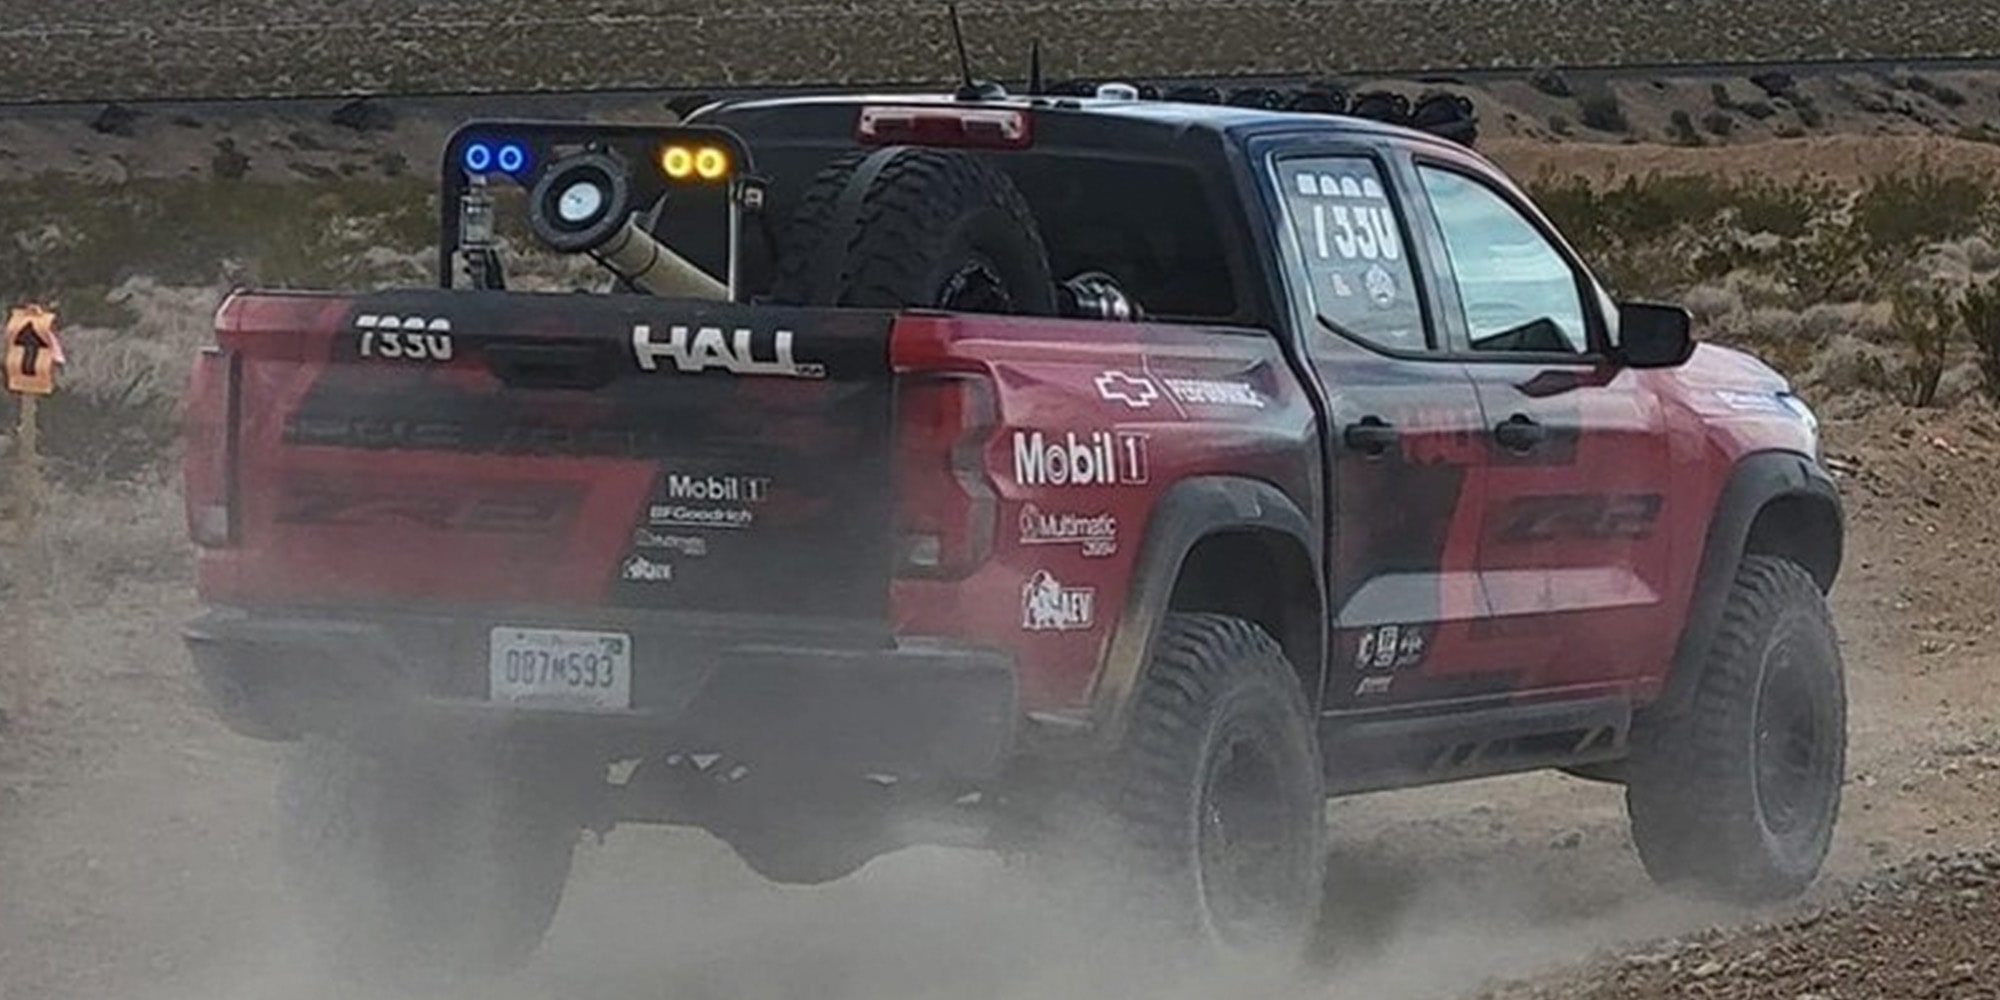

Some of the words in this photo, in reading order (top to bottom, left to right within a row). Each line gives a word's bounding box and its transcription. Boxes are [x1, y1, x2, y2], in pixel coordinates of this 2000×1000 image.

[355, 314, 454, 360] 7330
[633, 325, 796, 376] HALL
[1013, 431, 1116, 485] Mobil
[668, 474, 739, 500] Mobil
